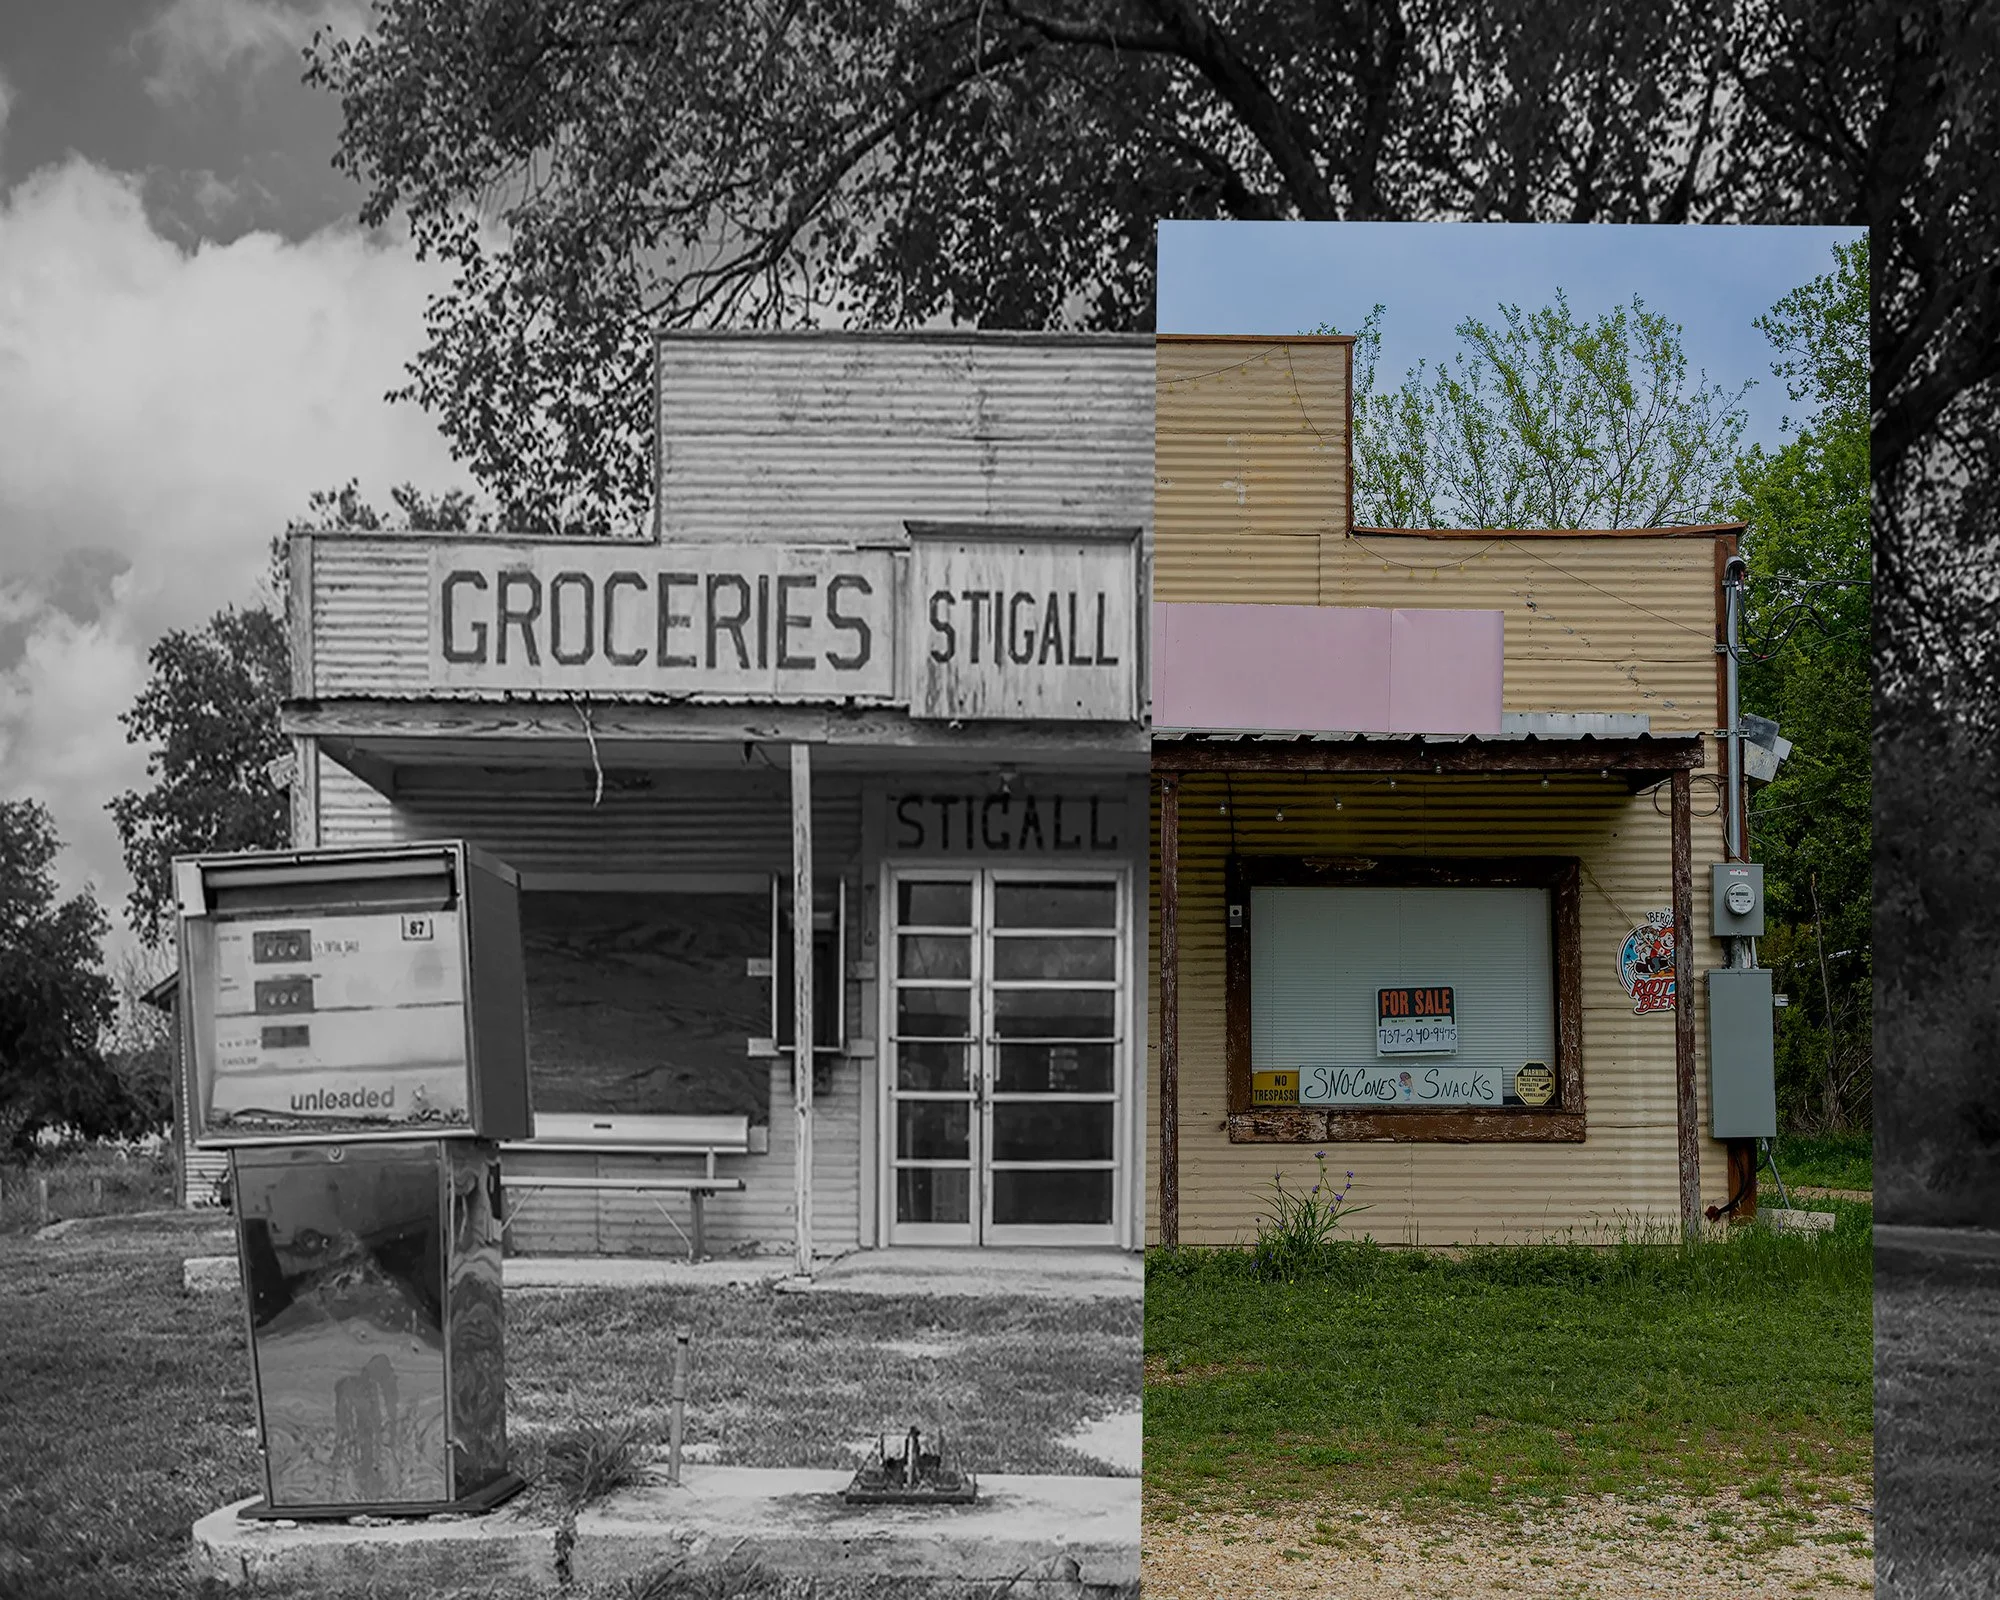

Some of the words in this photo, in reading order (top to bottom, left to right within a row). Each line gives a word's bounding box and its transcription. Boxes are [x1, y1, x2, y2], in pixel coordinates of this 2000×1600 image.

[441, 569, 872, 671] GROCERIES
[928, 589, 1119, 667] STIGALL
[895, 793, 1118, 851] STIGALL
[410, 921, 424, 935] 87
[1631, 979, 1676, 997] ROOT
[1381, 991, 1409, 1016] FOR
[1415, 989, 1451, 1015] SALE
[1636, 995, 1676, 1013] BEER
[1274, 1075, 1287, 1086] NO
[1304, 1067, 1397, 1101] SNO-CONES
[1417, 1068, 1494, 1100] SNACKS
[291, 1086, 395, 1111] unleaded
[1254, 1089, 1299, 1101] TRESPASSI
